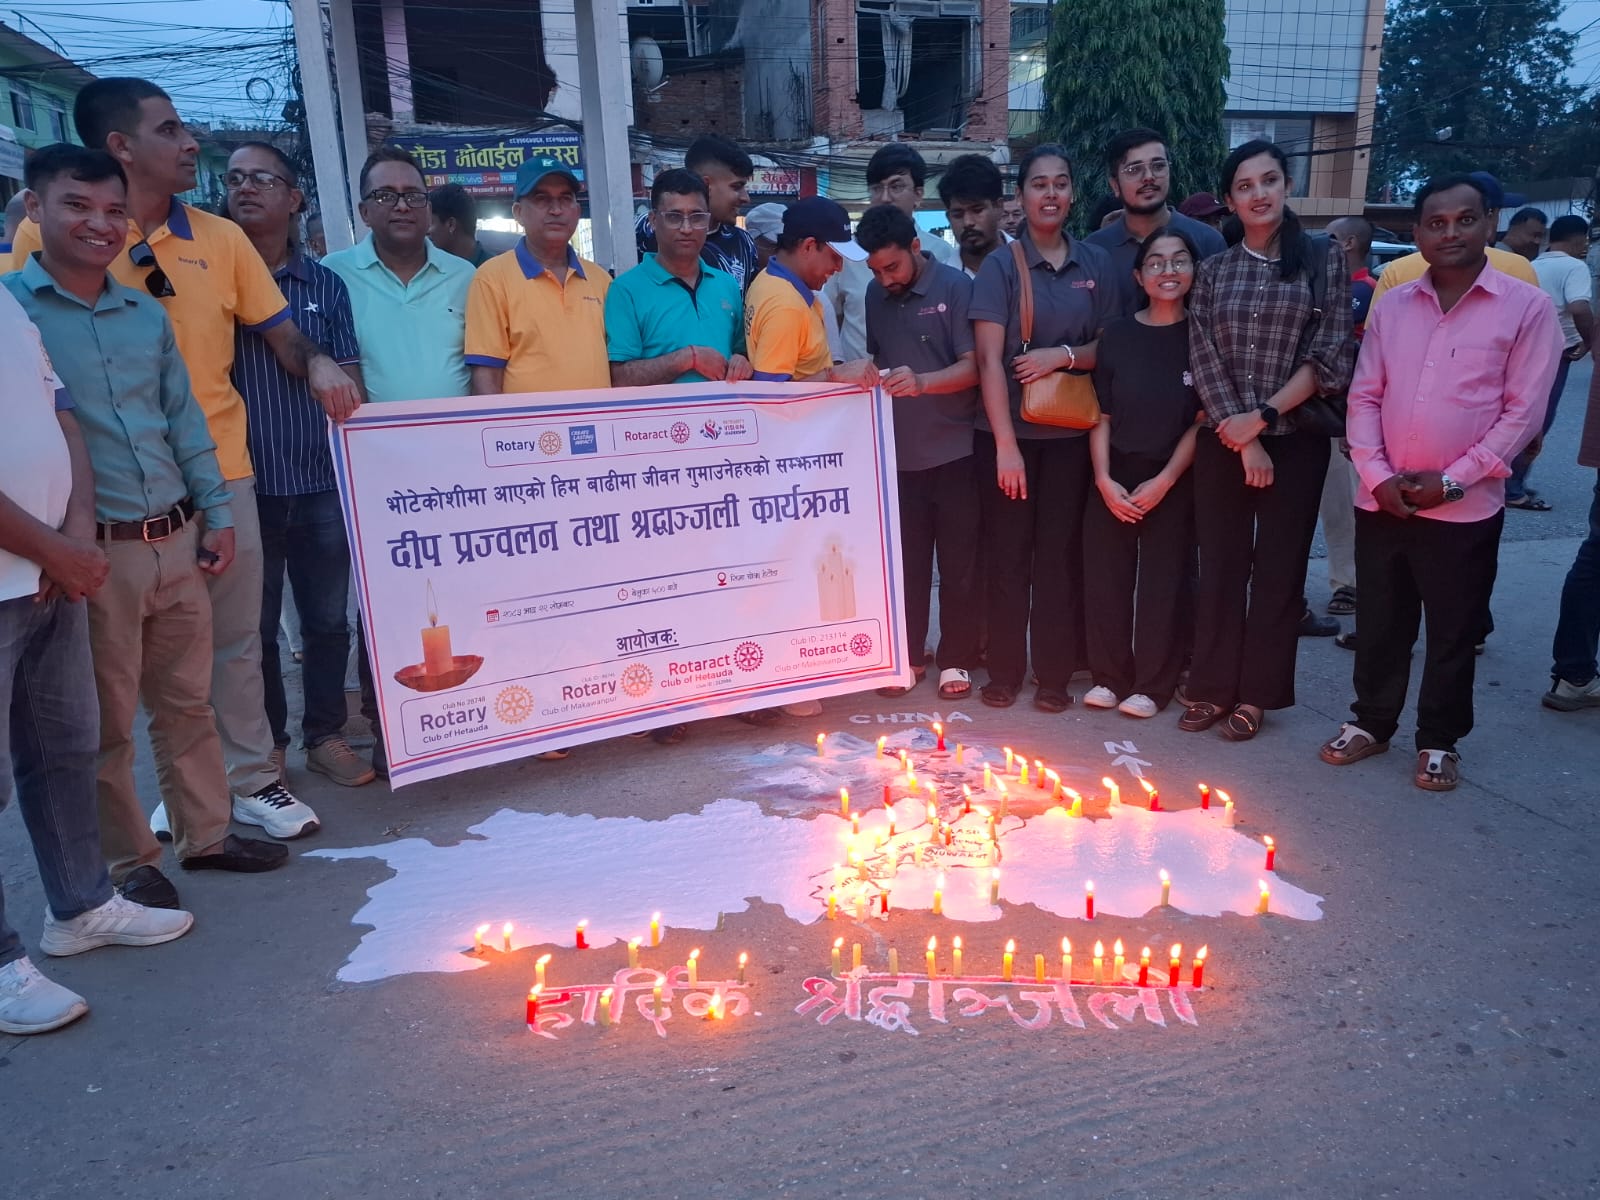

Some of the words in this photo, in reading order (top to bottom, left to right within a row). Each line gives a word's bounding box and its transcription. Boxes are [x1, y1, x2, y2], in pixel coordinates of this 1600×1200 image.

[624, 429, 668, 441] Rotaract
[496, 439, 536, 453] Rotary
[386, 484, 487, 515] भोटेकोशीमा
[494, 477, 545, 504] आएको
[551, 474, 580, 498] हिम
[587, 469, 636, 493] बाढीमा
[642, 465, 680, 487] जीवन
[686, 455, 770, 488] गुमाउनेहरुको
[387, 529, 442, 569] दीप
[450, 520, 559, 564] प्रज्वलन
[569, 512, 620, 547] तथा
[748, 484, 851, 525] कार्यक्रम
[799, 643, 848, 658] Rotaract
[668, 654, 731, 676] Rotaract
[774, 664, 792, 673] Club
[660, 677, 682, 688] Club
[683, 675, 693, 684] of
[695, 669, 733, 681] Hetauda
[562, 680, 617, 701] Rotary
[541, 706, 560, 716] Club
[560, 704, 570, 713] of
[570, 696, 617, 711] Makawanpur
[420, 706, 487, 732] Rotary
[849, 711, 973, 724] CHINA
[422, 733, 442, 744] Club
[443, 730, 453, 739] of
[454, 724, 489, 737] Hetauda
[1103, 740, 1140, 754] N
[930, 848, 988, 860] NUWAKOT
